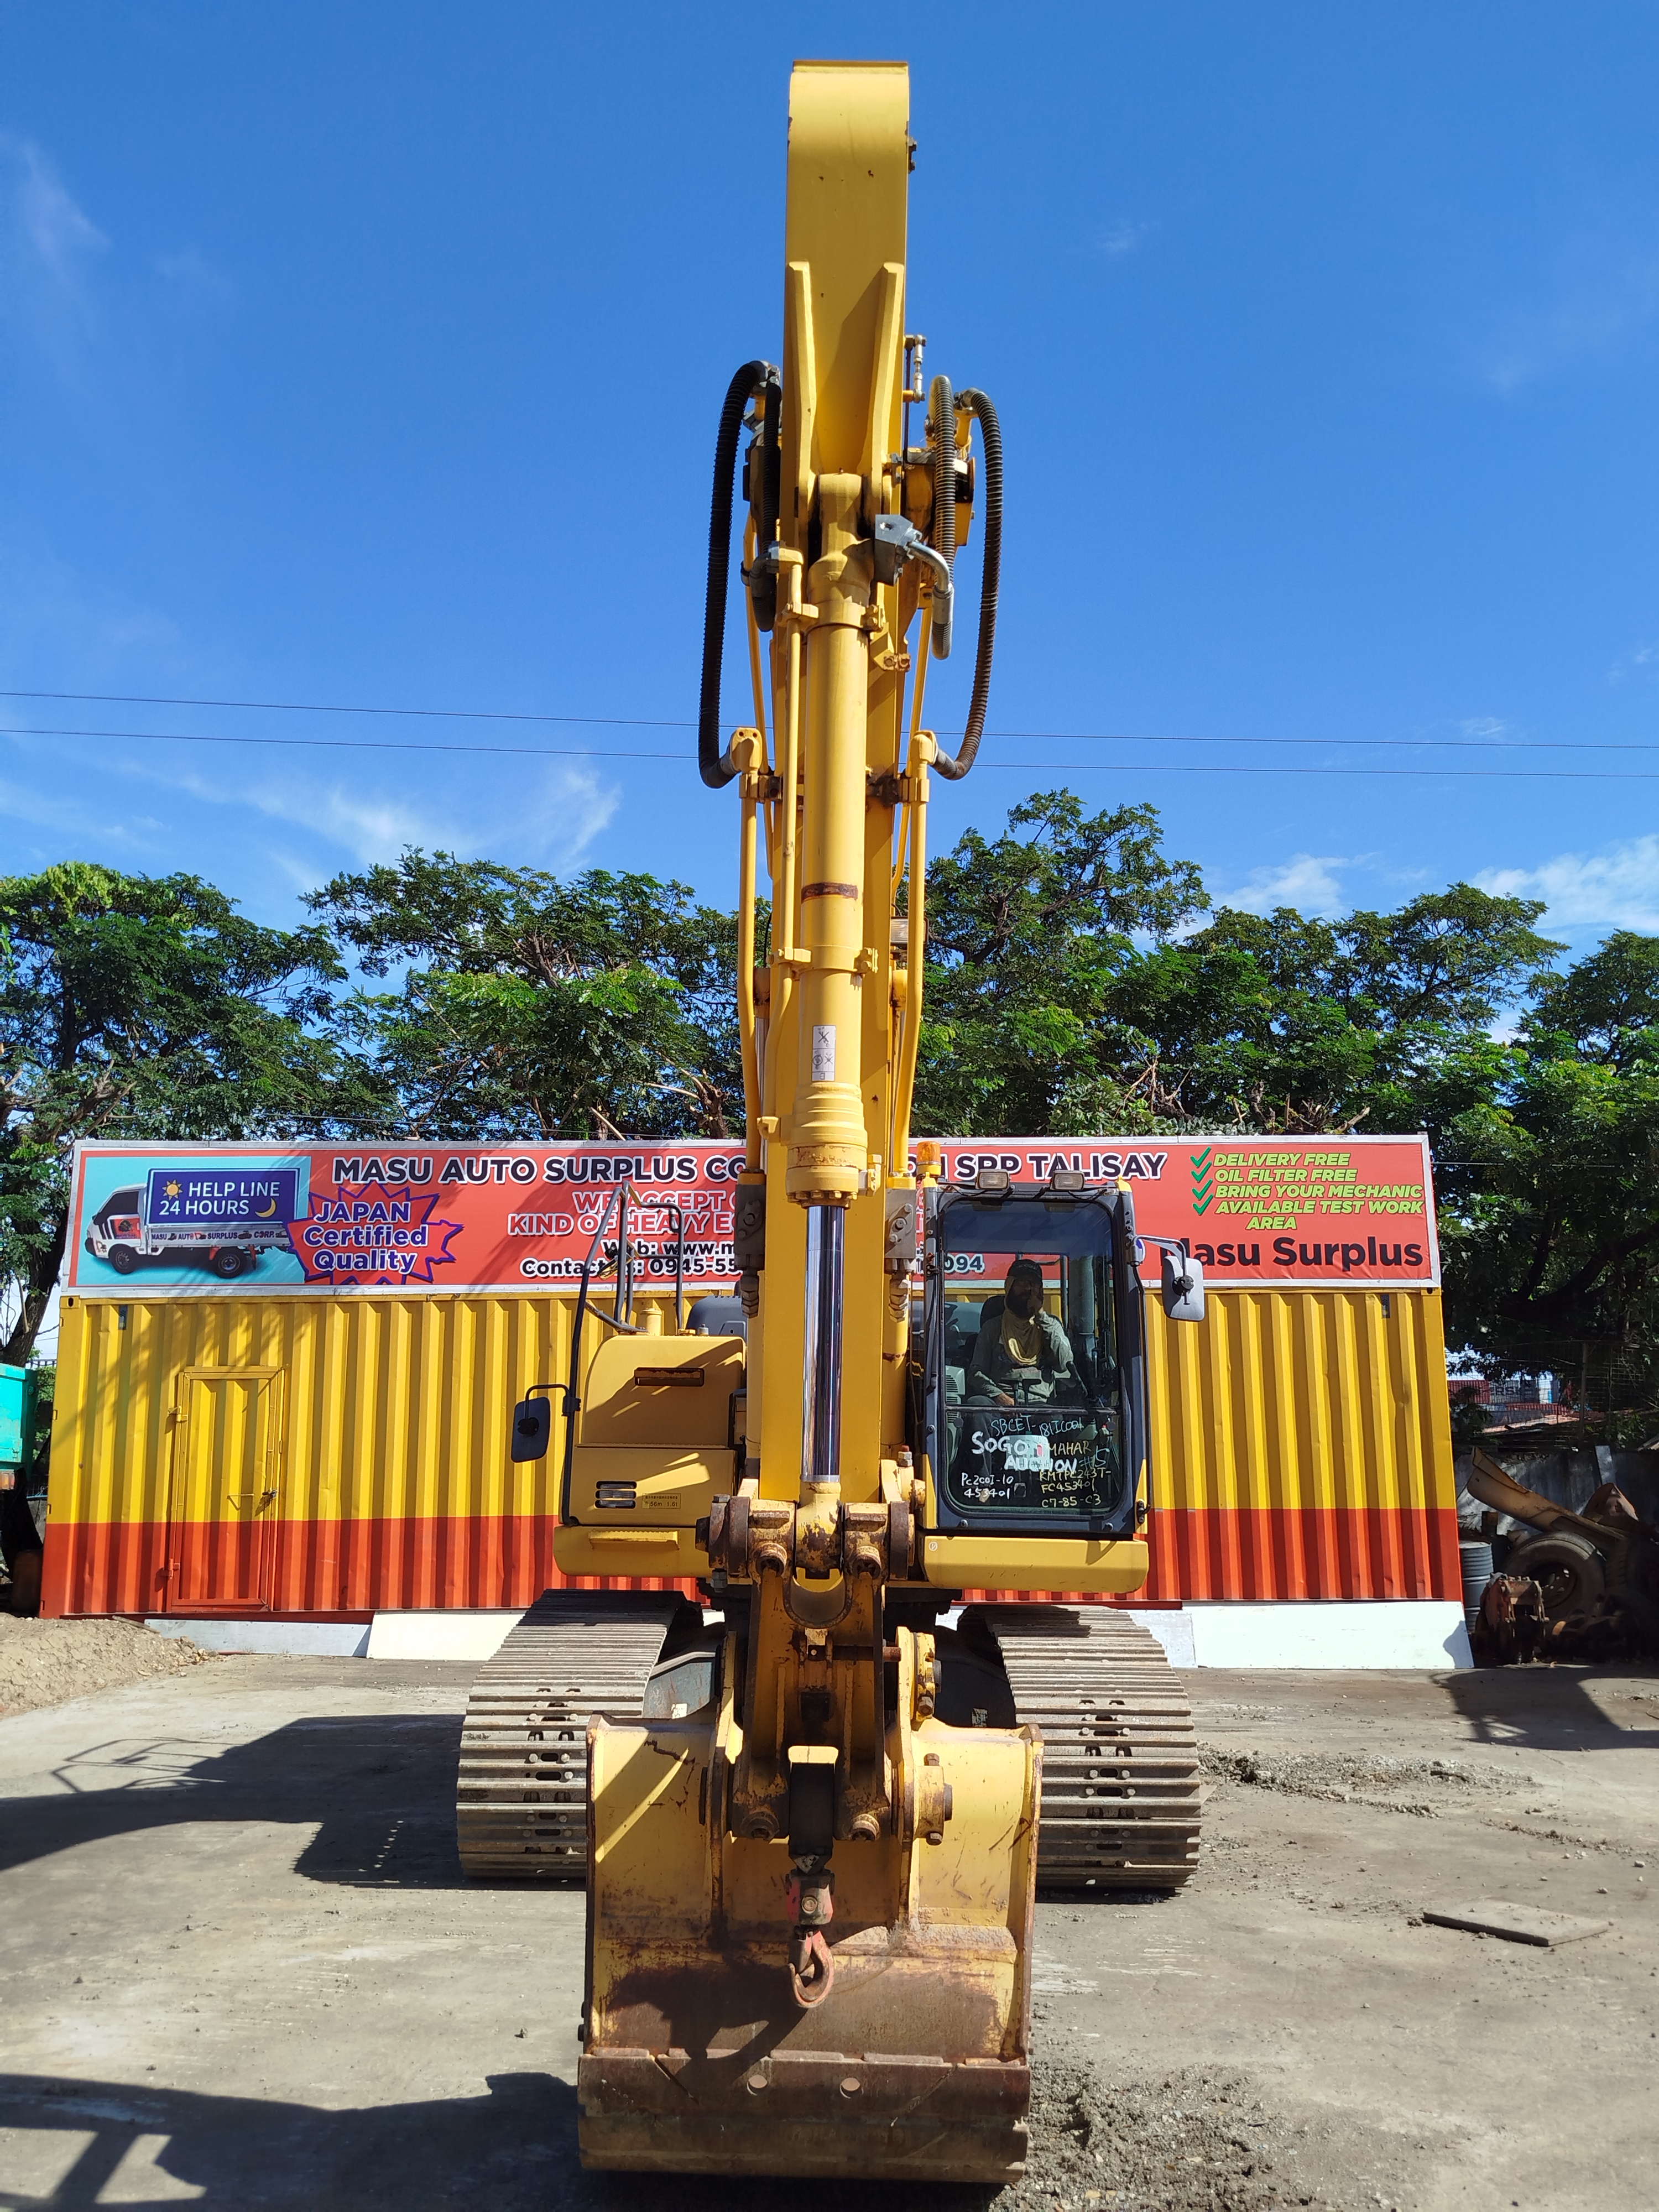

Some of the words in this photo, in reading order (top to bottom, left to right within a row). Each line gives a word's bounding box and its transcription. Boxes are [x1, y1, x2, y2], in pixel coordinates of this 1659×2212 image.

[333, 1157, 432, 1183] MASU
[440, 1156, 536, 1183] AUTO
[543, 1156, 697, 1183] SURPLUS
[704, 1155, 747, 1182] CO
[1027, 1152, 1167, 1180] TALISAY
[1214, 1153, 1301, 1166] DELIVERY
[1303, 1153, 1351, 1166] FREE
[1215, 1169, 1244, 1182] OIL
[1247, 1169, 1309, 1182] FILTER
[1311, 1168, 1358, 1182] FREE
[188, 1181, 237, 1198] HELP
[241, 1180, 280, 1197] LINE
[1215, 1185, 1271, 1198] BRING
[1276, 1185, 1326, 1198] YOUR
[1328, 1185, 1424, 1198] MECHANIC
[159, 1199, 181, 1215] 24
[185, 1199, 250, 1215] HOURS
[314, 1201, 411, 1223] JAPAN
[572, 1191, 618, 1213] WE
[627, 1191, 725, 1212] ACCEPT
[1215, 1200, 1315, 1214] AVAILABLE
[1321, 1200, 1366, 1214] TEST
[1369, 1200, 1425, 1214] WORK
[508, 1213, 574, 1235] KIND
[577, 1213, 617, 1235] OF
[1245, 1217, 1297, 1230] AREA
[207, 1232, 238, 1240] SURPLUS
[303, 1224, 429, 1247] Certified
[314, 1248, 418, 1275] Quality
[1273, 1236, 1423, 1271] Surplus
[972, 1431, 1029, 1455] SOGO
[963, 1487, 1010, 1500] 453401
